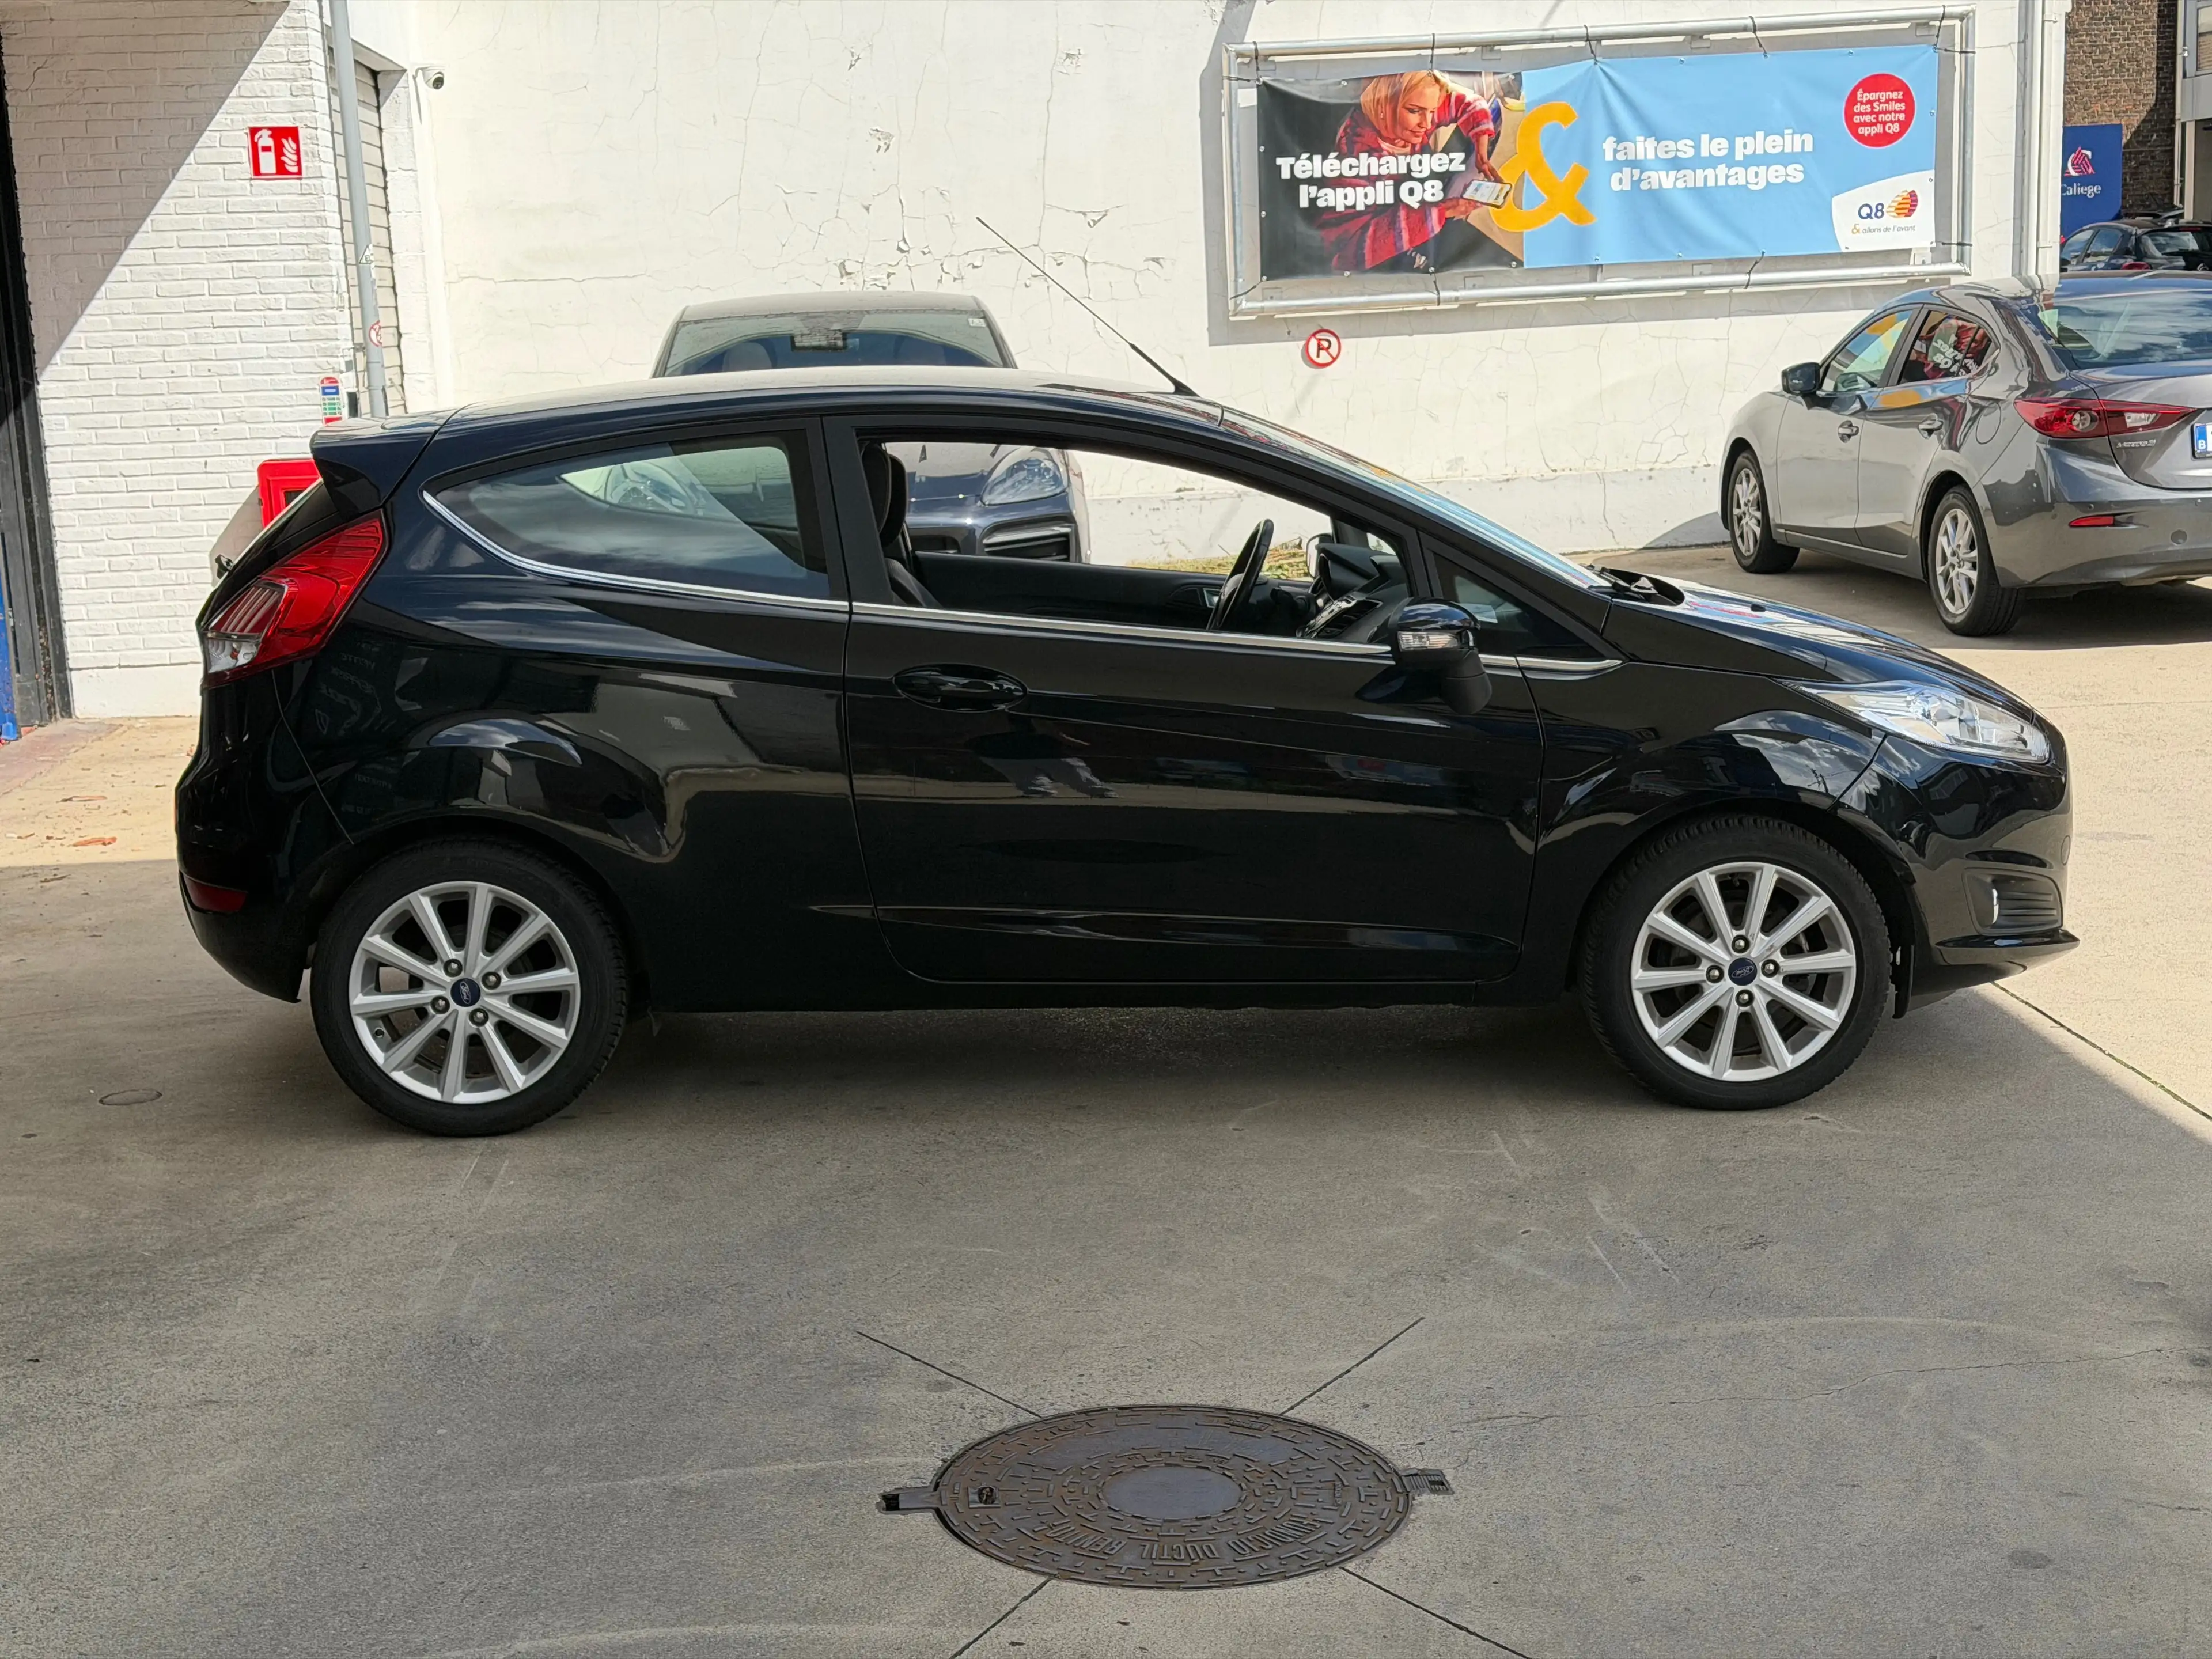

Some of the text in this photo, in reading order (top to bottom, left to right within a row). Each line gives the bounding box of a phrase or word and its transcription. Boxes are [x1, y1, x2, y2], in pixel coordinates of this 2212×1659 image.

[1857, 88, 1903, 103] Épargnez
[1853, 101, 1906, 112] des Smiles
[1853, 112, 1905, 123] avec notre
[1858, 122, 1900, 136] appli Q8
[1603, 129, 1813, 161] faites le plein
[1275, 151, 1466, 180] Téléchargez
[1610, 163, 1804, 191] d'avantages
[1299, 179, 1444, 211] l'appli Q8
[1858, 203, 1885, 220] Q8
[2198, 440, 2206, 449] B
[1046, 1525, 1128, 1555] BENITO
